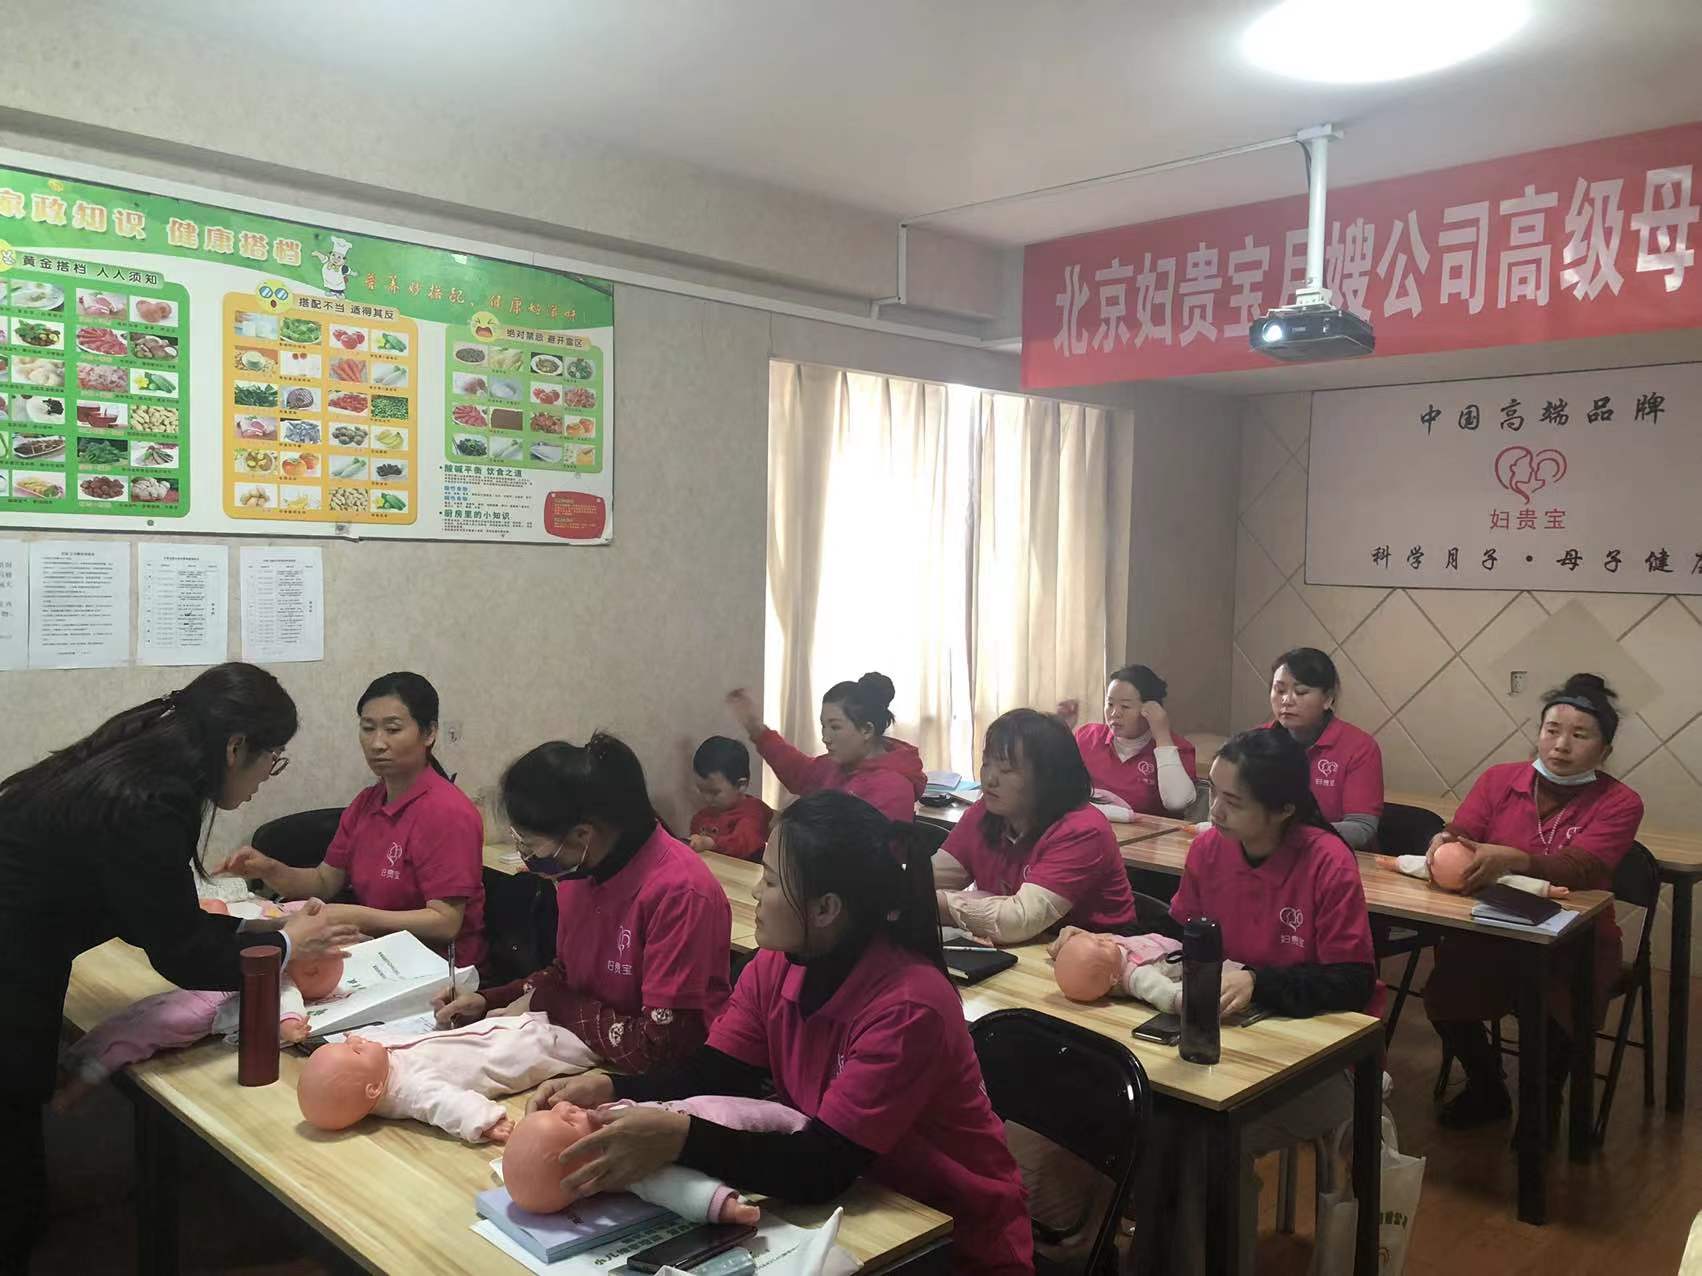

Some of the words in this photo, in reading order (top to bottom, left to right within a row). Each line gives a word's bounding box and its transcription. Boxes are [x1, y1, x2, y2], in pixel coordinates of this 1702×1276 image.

[167, 217, 302, 266] 健康搭档
[23, 255, 87, 275] 黄金搭档
[96, 267, 157, 285] 人人须知
[299, 298, 344, 313] 搭配不当
[351, 304, 394, 320] 适得其反
[1420, 392, 1666, 436] 中国高端品牌
[1489, 508, 1567, 530] 妇贵宝
